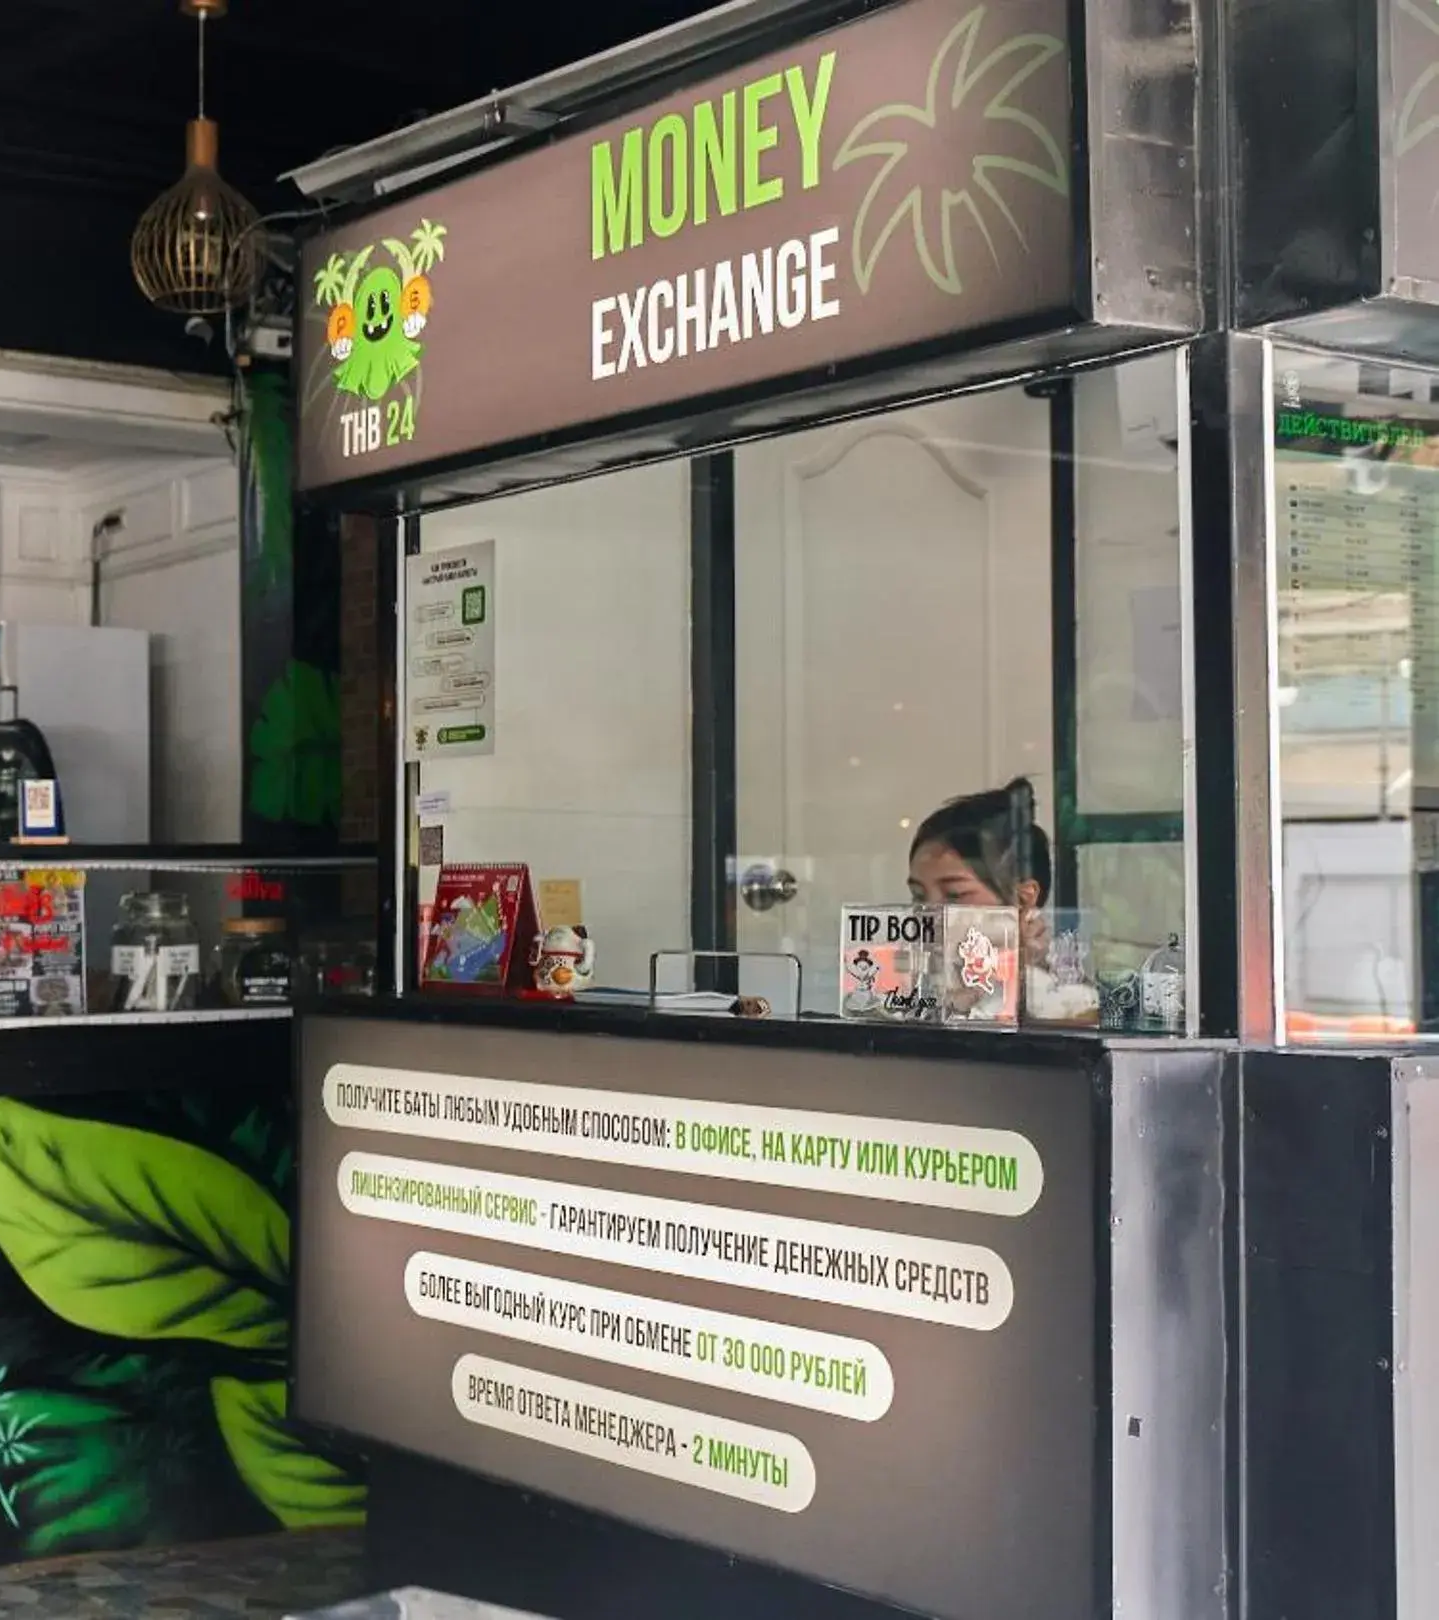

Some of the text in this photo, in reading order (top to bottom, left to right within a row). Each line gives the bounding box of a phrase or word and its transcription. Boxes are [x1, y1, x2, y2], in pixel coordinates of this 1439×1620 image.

[592, 51, 837, 261] MONEY
[592, 226, 840, 381] EXCHANGE
[340, 394, 415, 457] THB 24
[848, 915, 935, 943] TIP BOX
[337, 1083, 1018, 1191] ПОЛУЧИТЕ БАТЫ ЛЮБЫМ УДОБНЫМ СПОСОБОМ: В ОФИСЕ, НА КАРТУ ИЛИ КУРЬЕРОМ
[351, 1169, 483, 1216] ЛИЦЕНЗИРОВАННЫЙ
[484, 1191, 538, 1226] СЕРВИС
[550, 1202, 661, 1249] ГАРАНТИРУЕМ
[664, 1222, 769, 1268] ПОЛУЧЕНИЕ
[774, 1239, 890, 1289] ДЕНЕЖНЫХ
[895, 1259, 989, 1305] СРЕДСТВ
[419, 1272, 867, 1398] БОЛЕЕ ВЫГОДНЫЙ КУРС ПРИ ОБМЕНЕ ОТ 30 000 РУБЛЕЙ
[469, 1374, 515, 1411] ВРЕМЯ
[518, 1387, 572, 1430] ОТВЕТА
[574, 1403, 678, 1458] МЕНЕДЖЕРА
[692, 1436, 704, 1466] 2
[708, 1442, 789, 1489] МИНУТЫ
